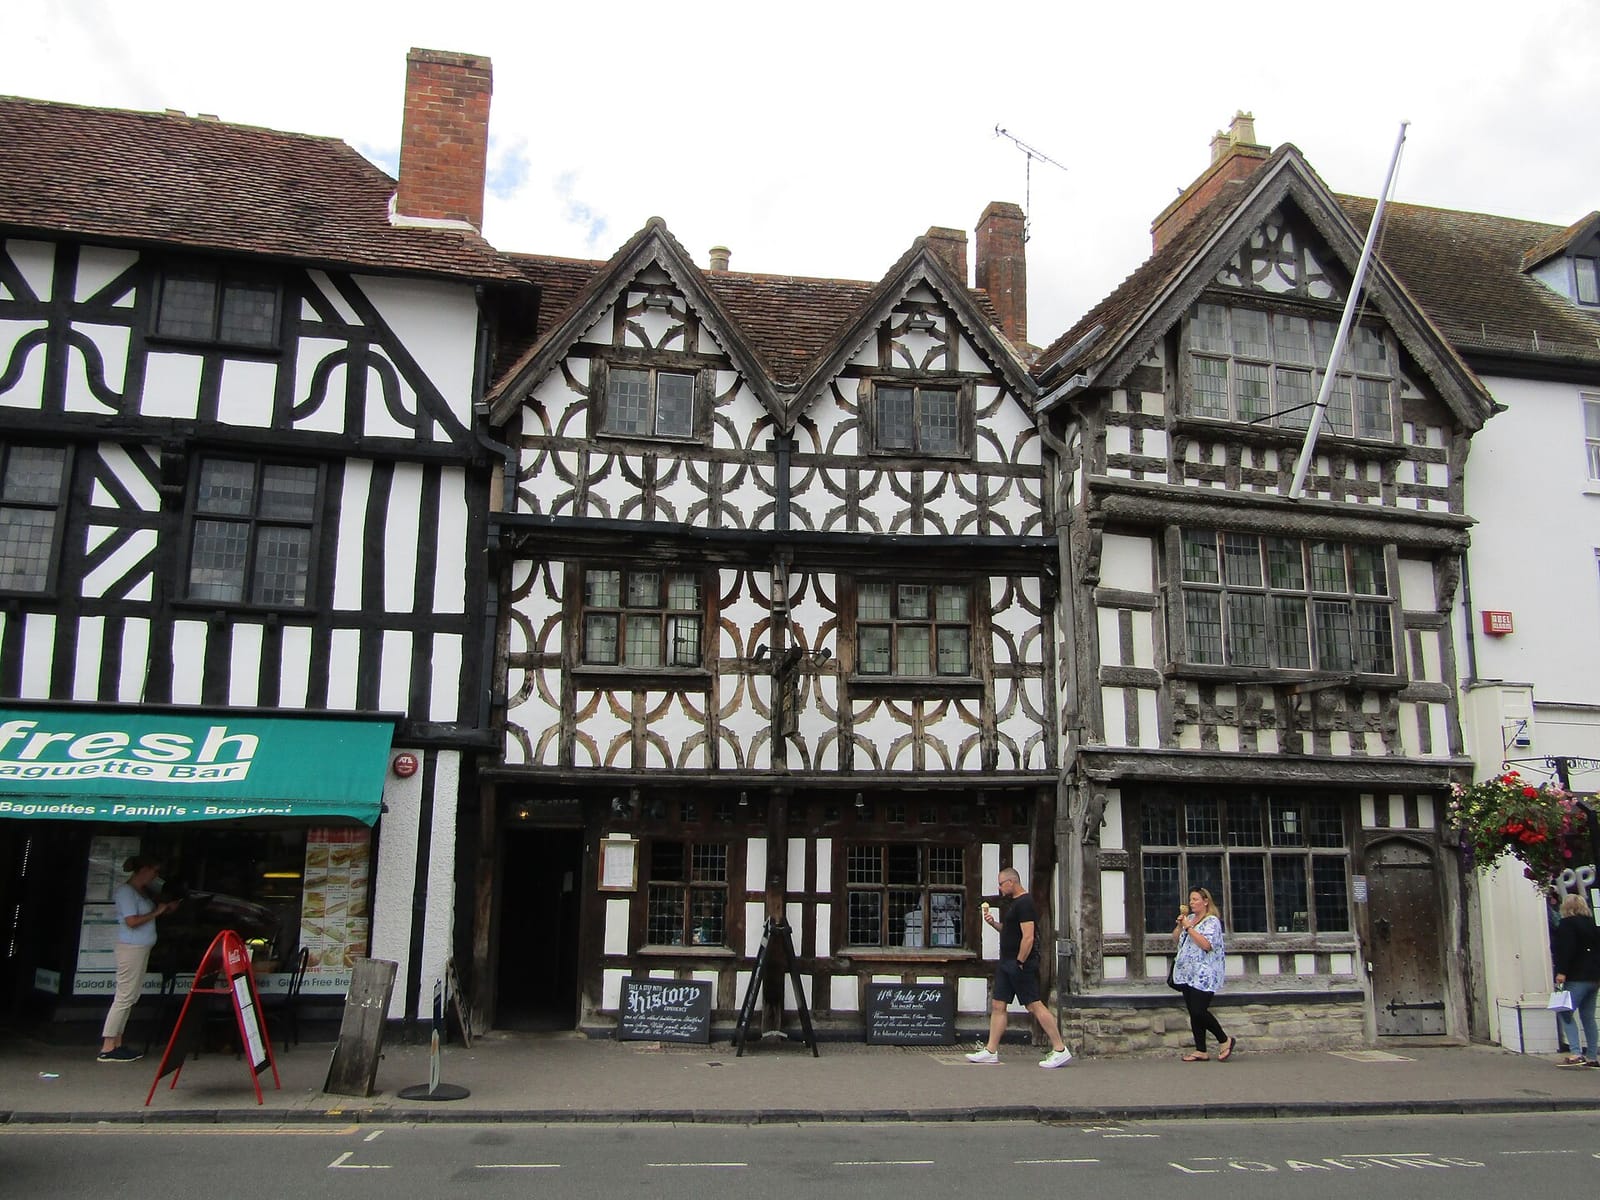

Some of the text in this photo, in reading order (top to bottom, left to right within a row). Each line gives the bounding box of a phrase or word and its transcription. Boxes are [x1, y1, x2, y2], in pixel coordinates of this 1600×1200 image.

[0, 720, 259, 762] fresh
[168, 766, 239, 779] Bar
[0, 802, 95, 814] Baguettes
[113, 804, 187, 816] Panini's
[76, 979, 105, 989] Salad
[313, 978, 333, 986] Free
[894, 990, 916, 1003] July
[918, 989, 941, 1002] 1564
[1167, 1156, 1487, 1173] LOADING
